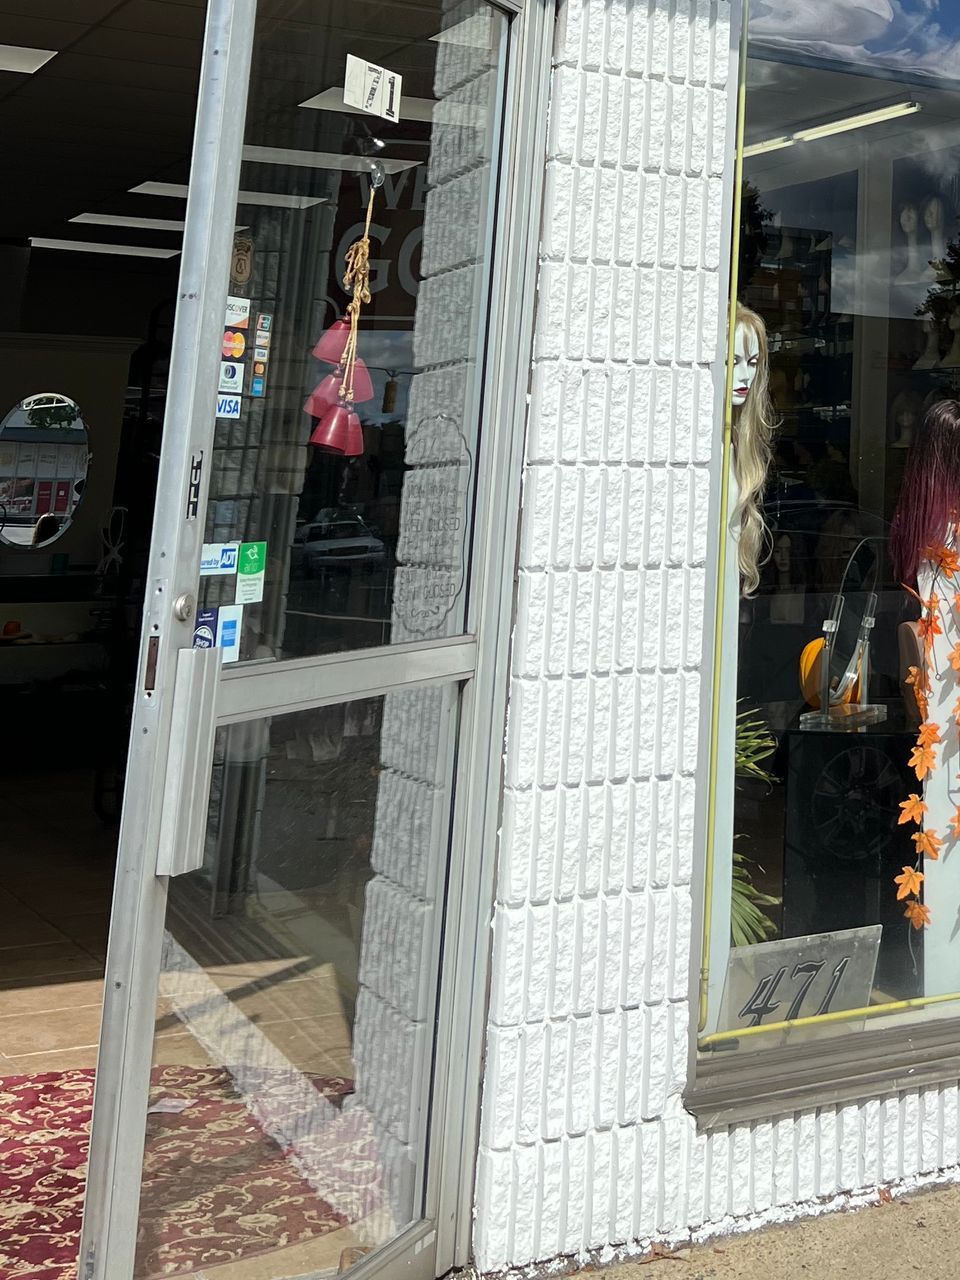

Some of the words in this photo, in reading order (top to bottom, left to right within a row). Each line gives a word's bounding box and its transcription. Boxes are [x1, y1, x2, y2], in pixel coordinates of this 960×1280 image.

[217, 398, 240, 414] VISA
[221, 550, 236, 566] ADT
[738, 957, 851, 1028] 471
